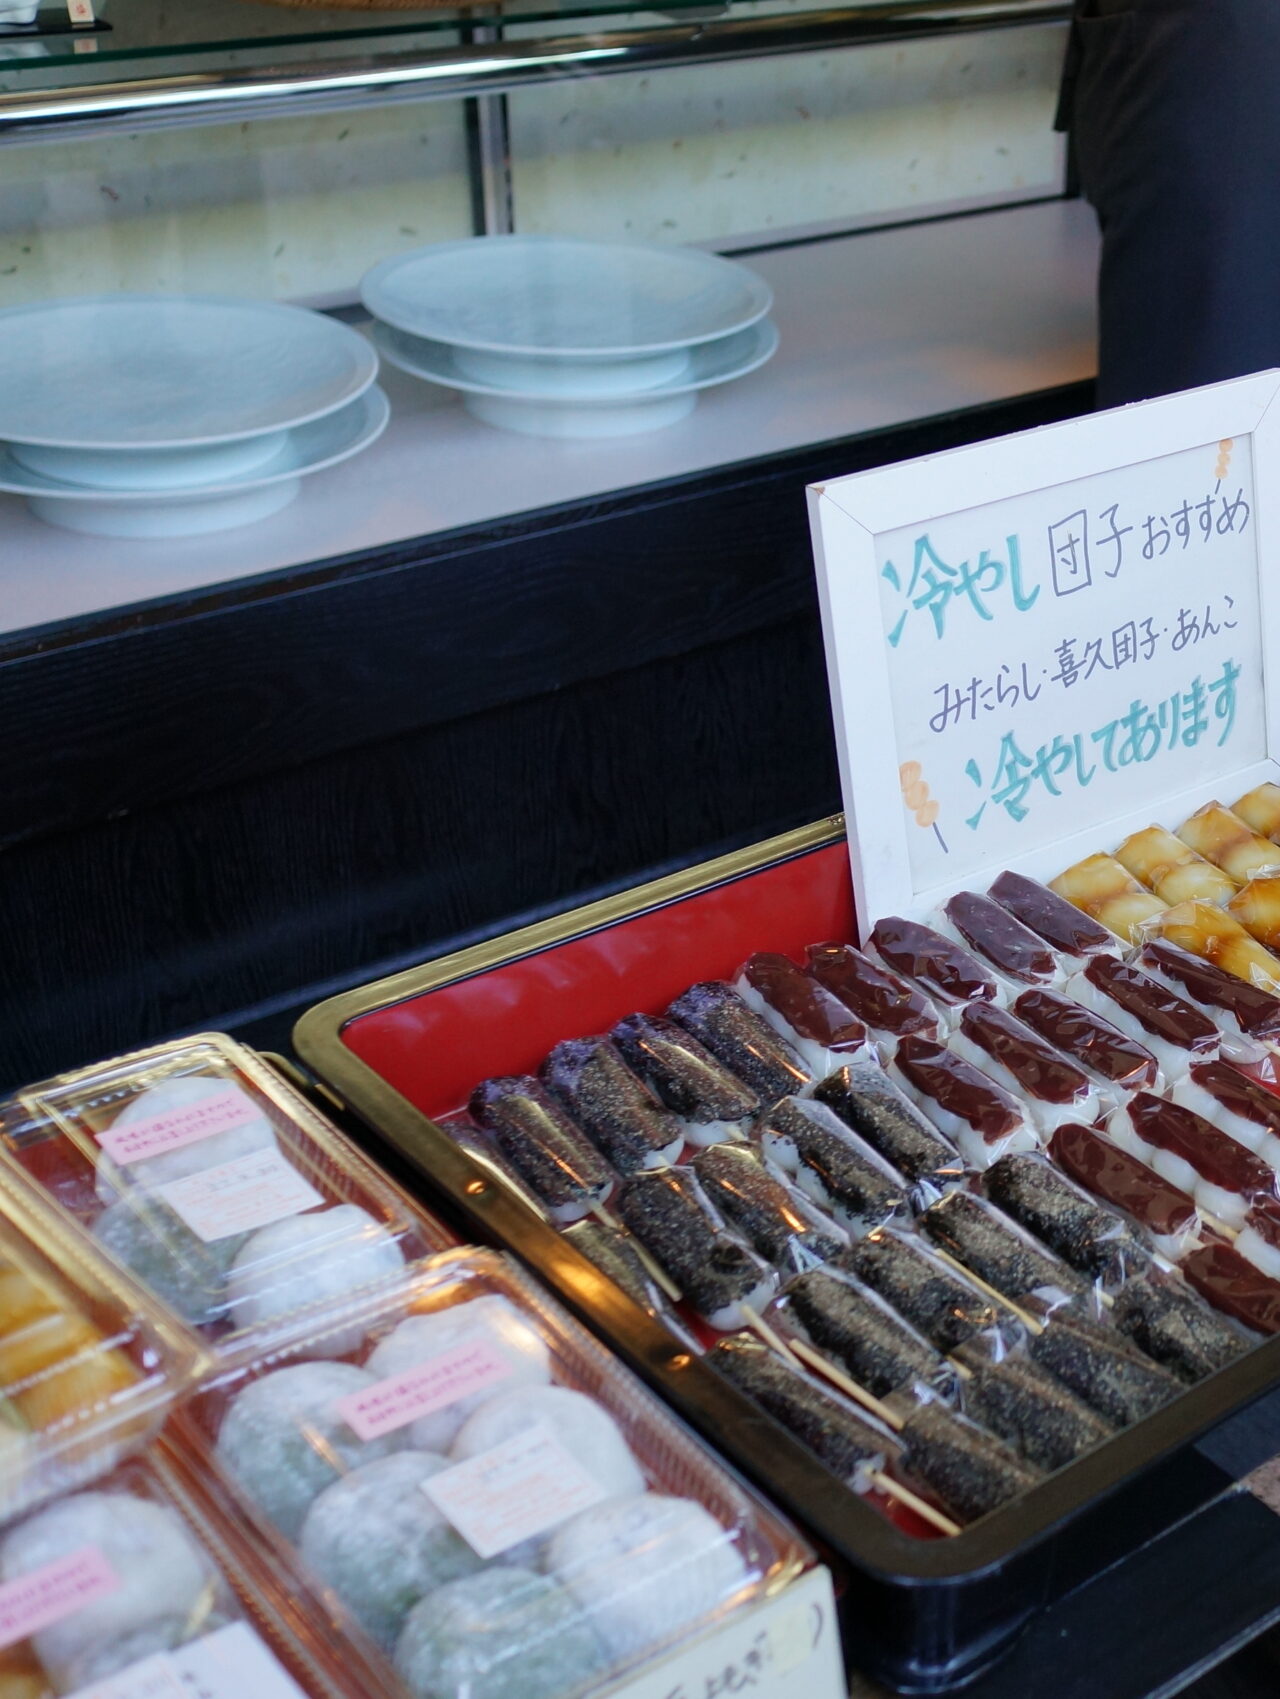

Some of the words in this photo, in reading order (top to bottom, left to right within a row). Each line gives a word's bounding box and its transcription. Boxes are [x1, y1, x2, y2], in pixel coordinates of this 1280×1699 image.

[965, 657, 1241, 830] 冷やしてあります
